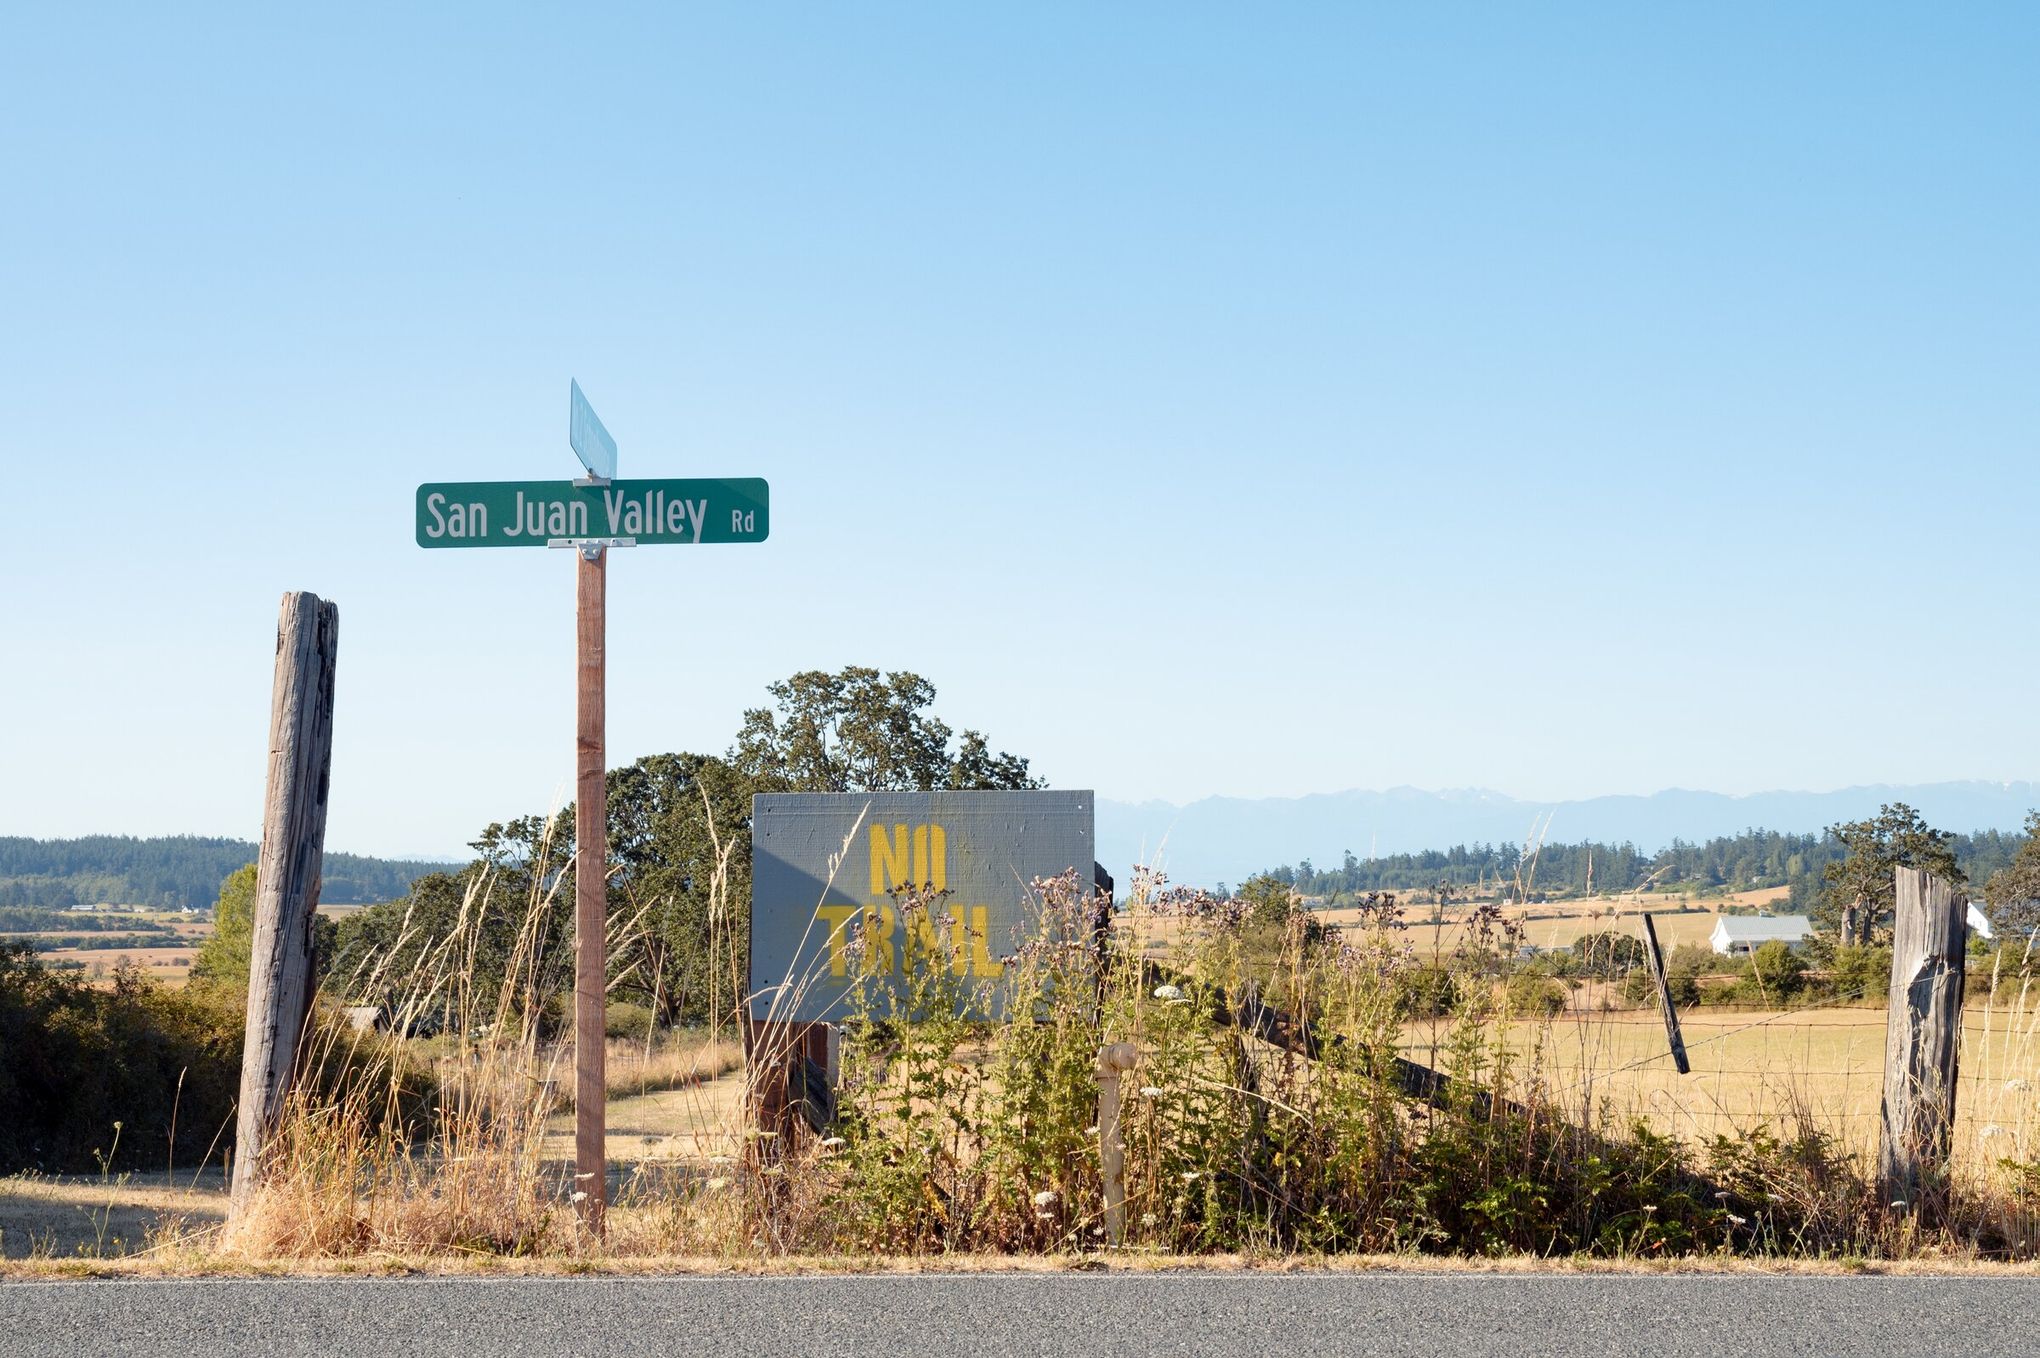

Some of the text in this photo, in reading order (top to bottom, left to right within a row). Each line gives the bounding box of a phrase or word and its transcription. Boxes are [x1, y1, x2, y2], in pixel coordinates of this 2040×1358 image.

[426, 489, 755, 544] San Juan Valley Rd
[868, 823, 947, 896] NO
[816, 904, 1005, 978] TRAIL
